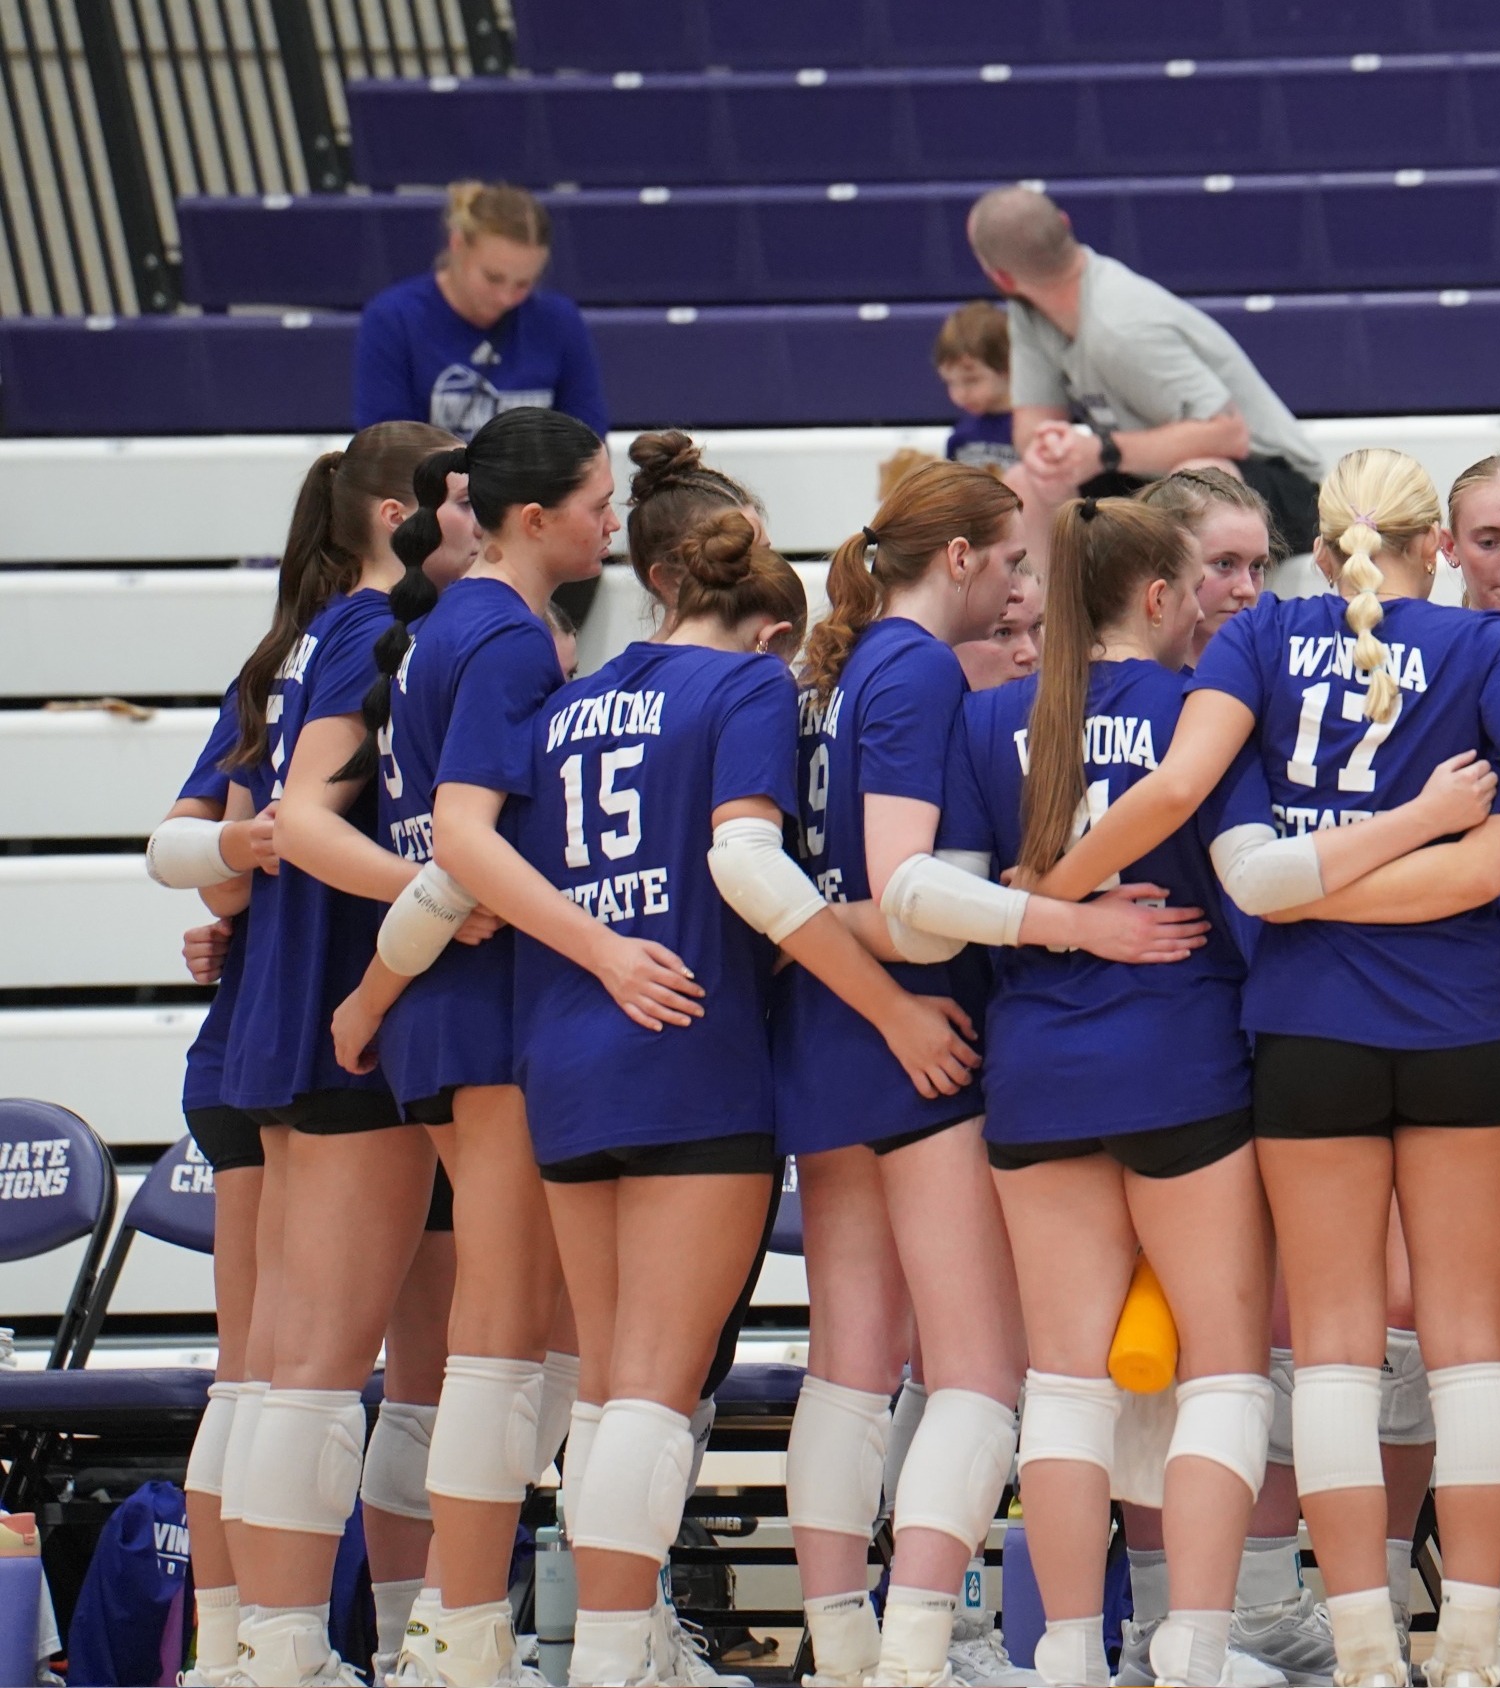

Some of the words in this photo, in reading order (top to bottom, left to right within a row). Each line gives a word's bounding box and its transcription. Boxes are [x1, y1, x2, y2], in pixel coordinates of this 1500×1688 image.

[547, 689, 665, 753] WINONA
[1287, 682, 1403, 792] 17
[559, 743, 643, 869] 15
